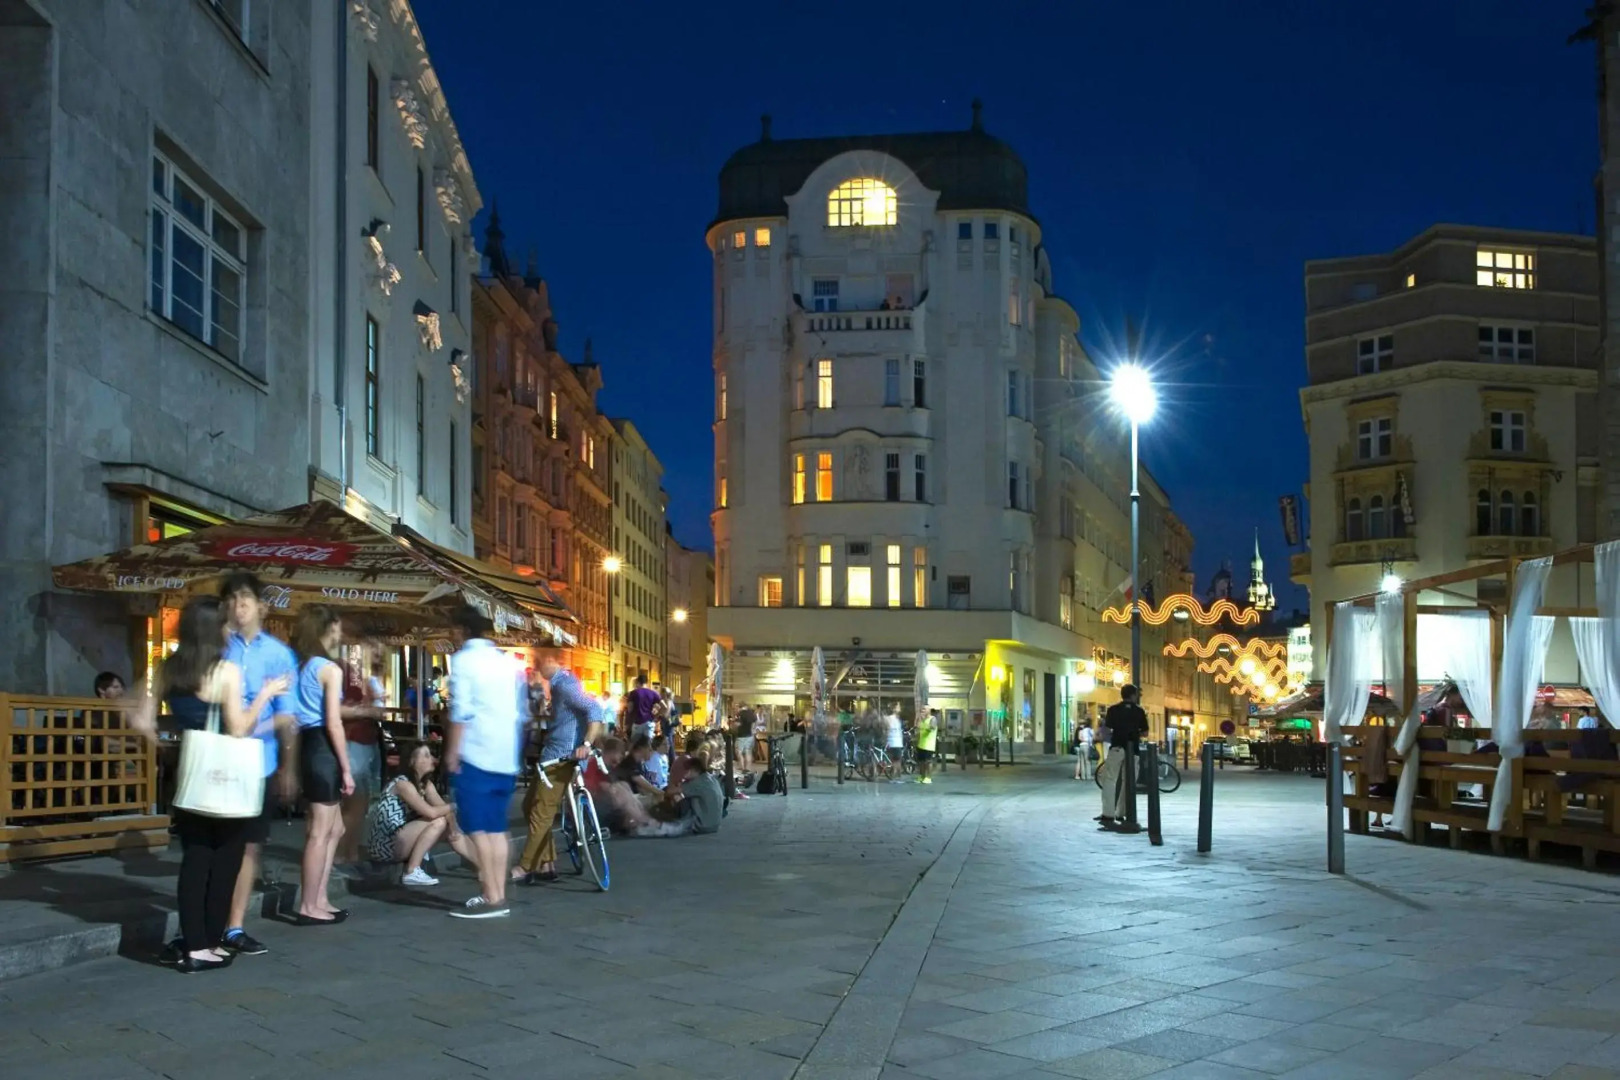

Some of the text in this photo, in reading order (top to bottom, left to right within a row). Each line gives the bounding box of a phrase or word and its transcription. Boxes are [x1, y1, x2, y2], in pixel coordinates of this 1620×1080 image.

[227, 542, 337, 561] Coca-Cola
[118, 575, 140, 587] ICE
[144, 576, 185, 589] COLD
[321, 587, 359, 600] SOLD
[363, 590, 399, 603] HERE
